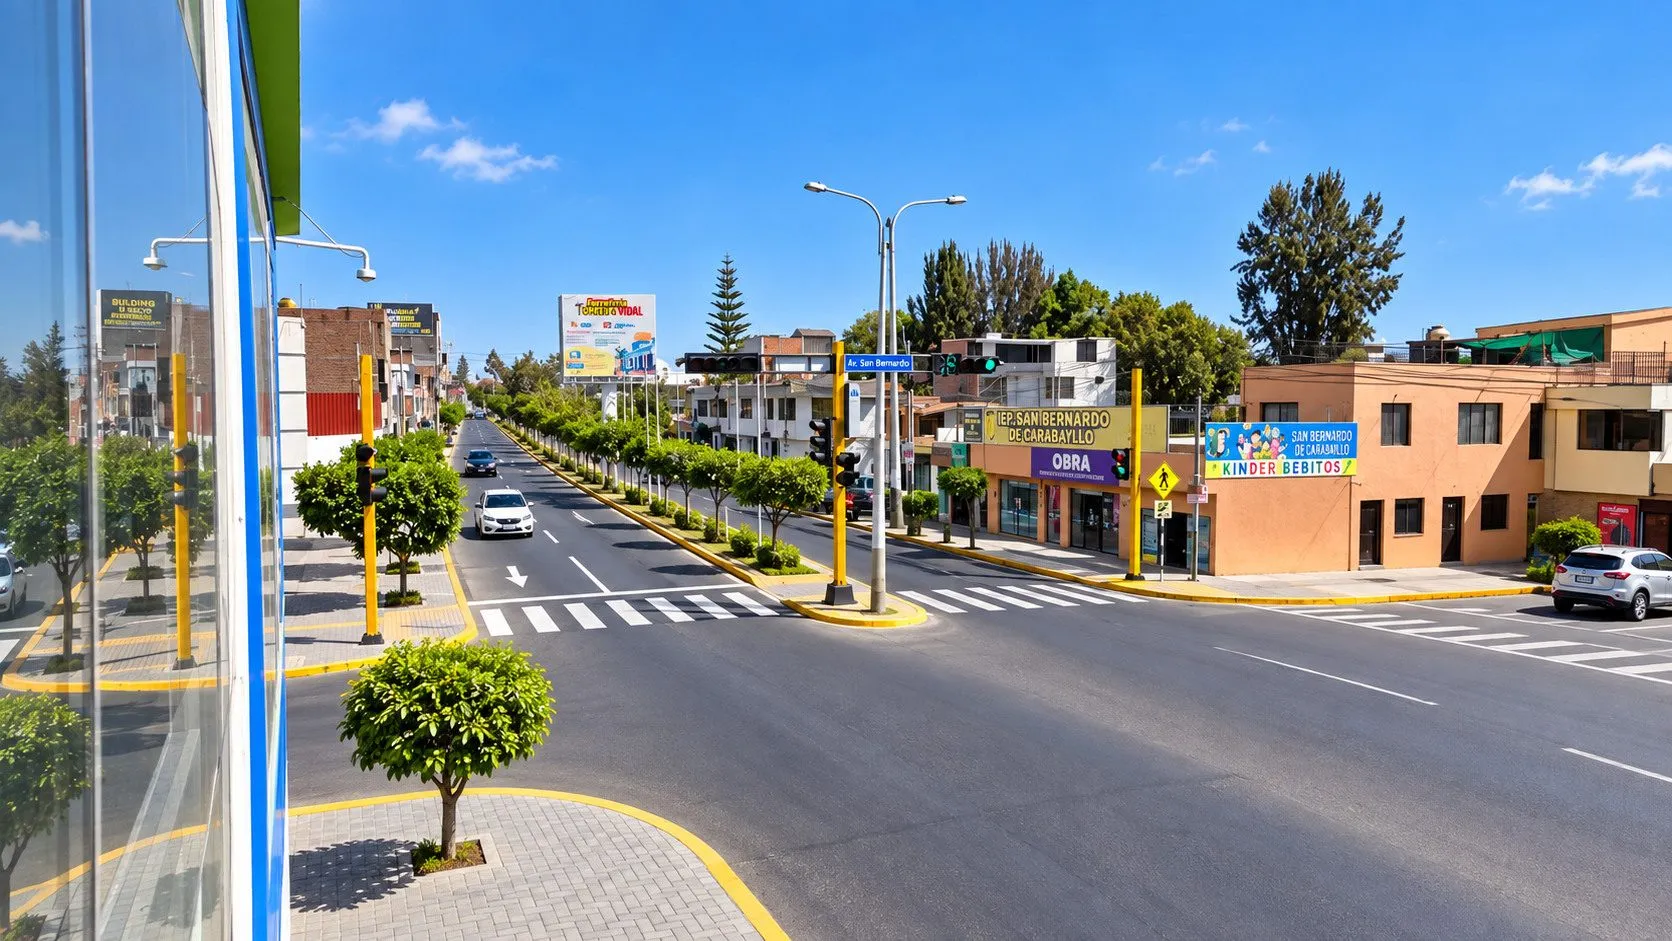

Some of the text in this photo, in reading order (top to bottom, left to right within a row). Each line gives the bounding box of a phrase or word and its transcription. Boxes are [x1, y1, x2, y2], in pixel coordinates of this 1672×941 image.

[618, 305, 644, 316] VIDAL
[876, 359, 910, 367] Bernardo
[1016, 411, 1039, 427] SAN
[1043, 411, 1110, 428] BERNARDO
[1009, 427, 1094, 445] DE CARABAYLLO
[1291, 430, 1353, 443] SAN BERNARDO
[1294, 444, 1305, 457] DE
[1052, 452, 1091, 473] OBRA
[1222, 460, 1341, 476] KINDER BEBITOS
